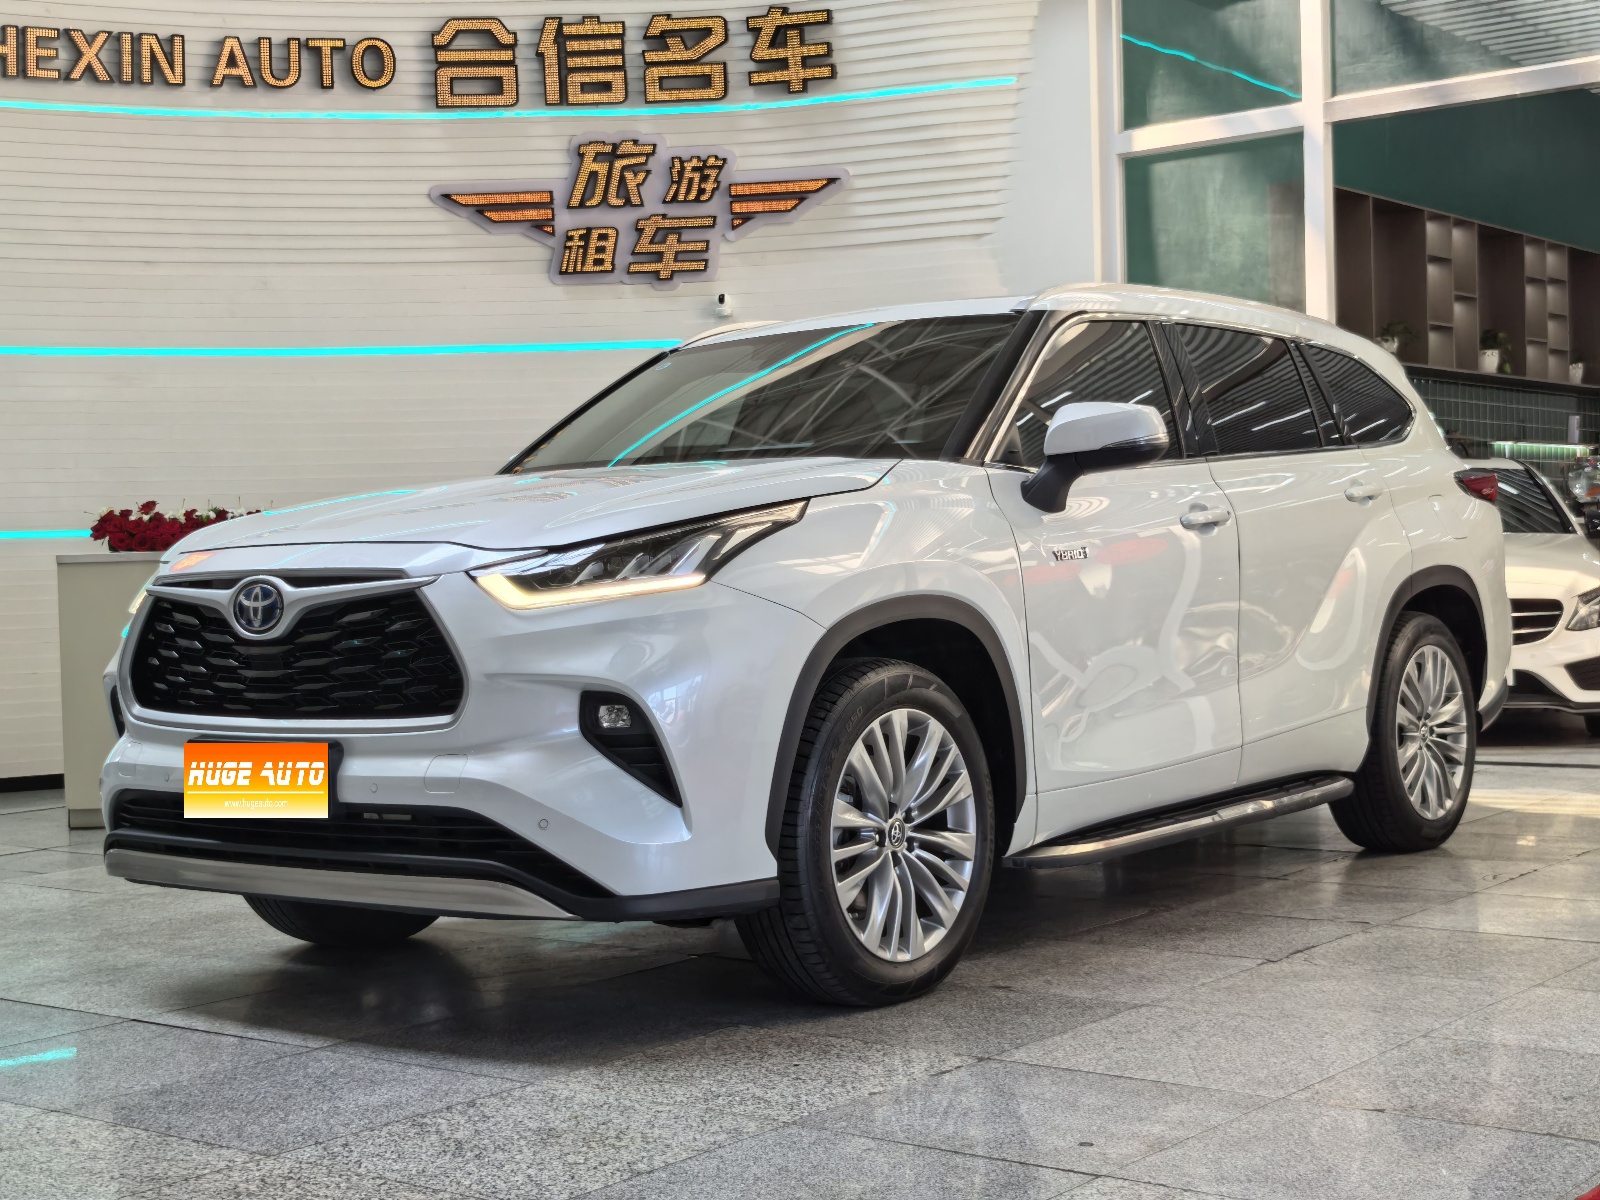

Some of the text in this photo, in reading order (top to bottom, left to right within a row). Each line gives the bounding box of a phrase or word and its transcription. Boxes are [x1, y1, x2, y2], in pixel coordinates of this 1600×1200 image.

[209, 36, 397, 90] AUTO
[432, 6, 837, 108] 合信名车
[567, 139, 728, 210] 旅游
[559, 213, 717, 281] 租车
